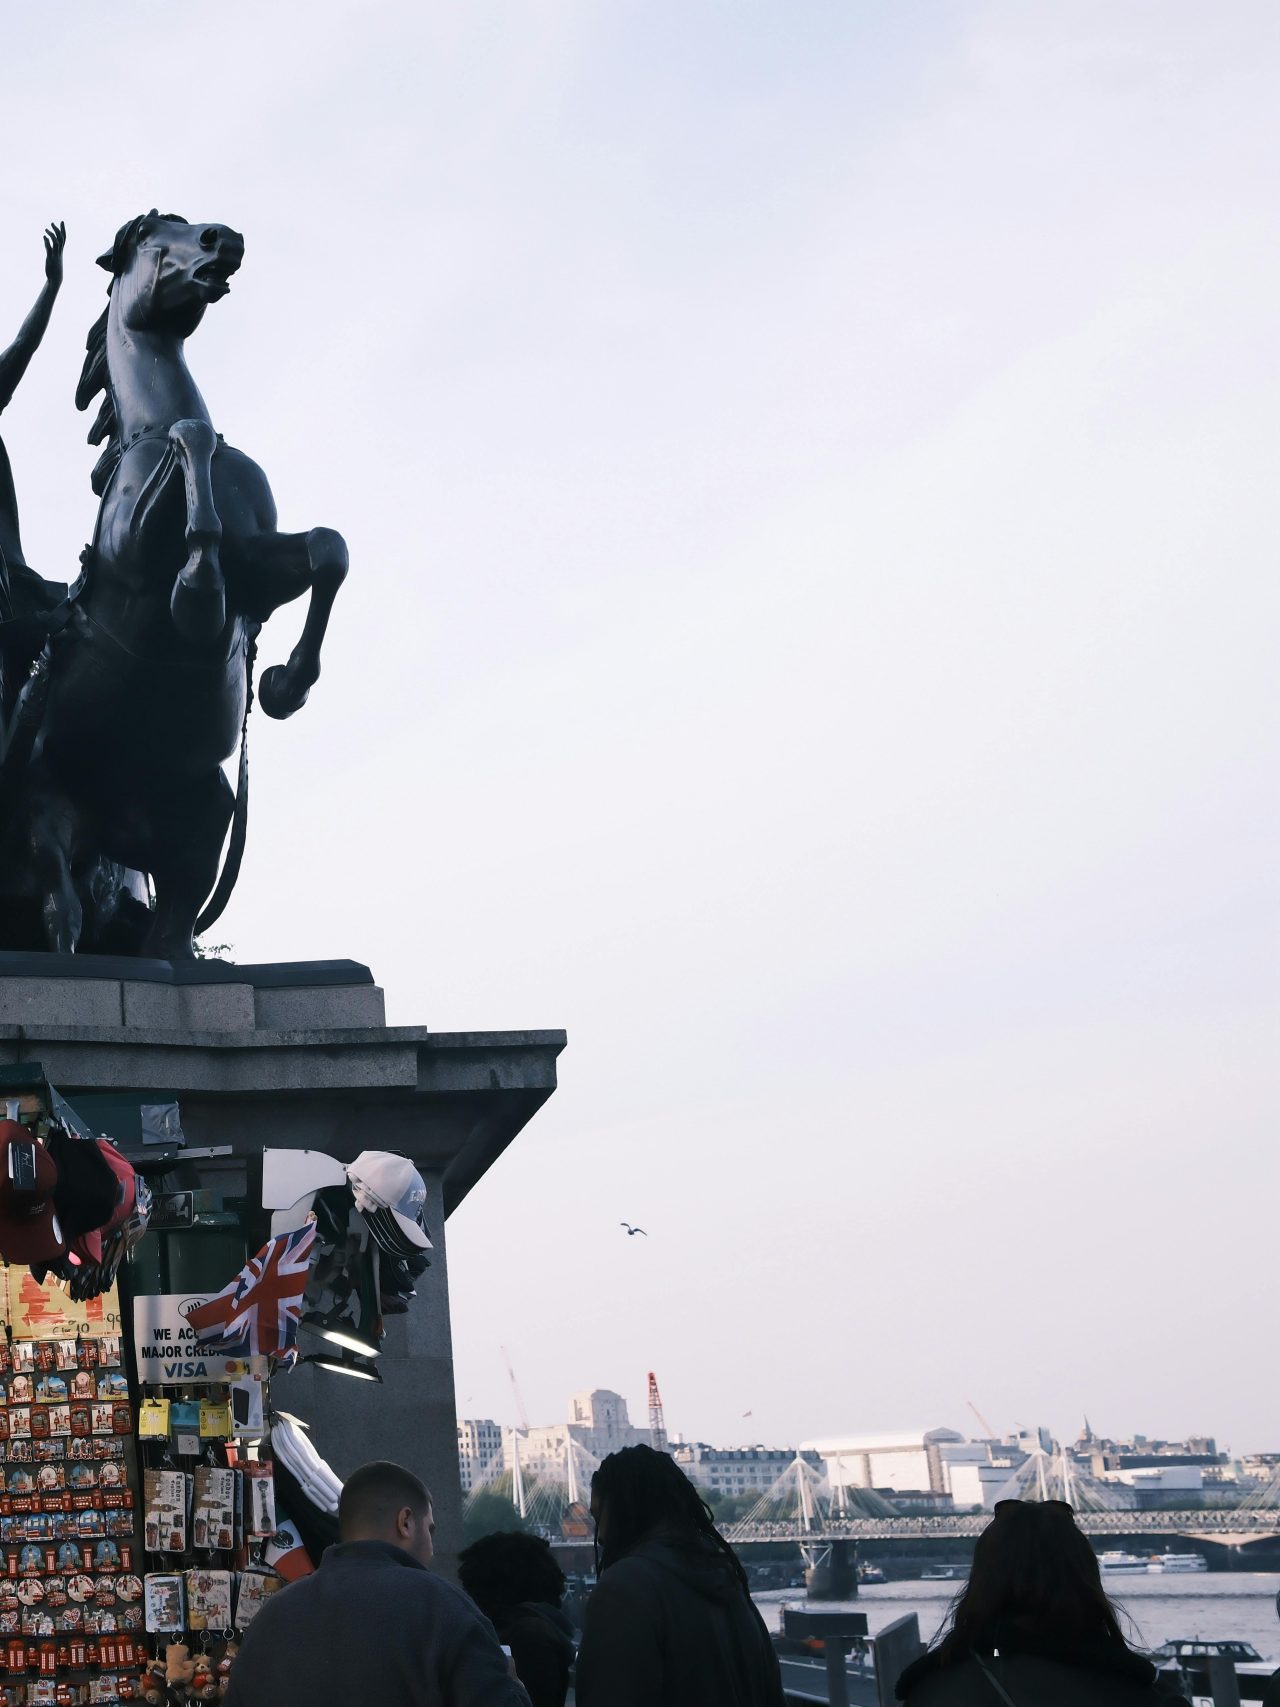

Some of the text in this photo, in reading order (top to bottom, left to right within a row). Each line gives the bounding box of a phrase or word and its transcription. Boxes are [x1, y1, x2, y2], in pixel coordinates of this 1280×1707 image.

[153, 1328, 172, 1341] WE
[141, 1345, 183, 1359] MAJOR
[164, 1362, 208, 1378] VISA
